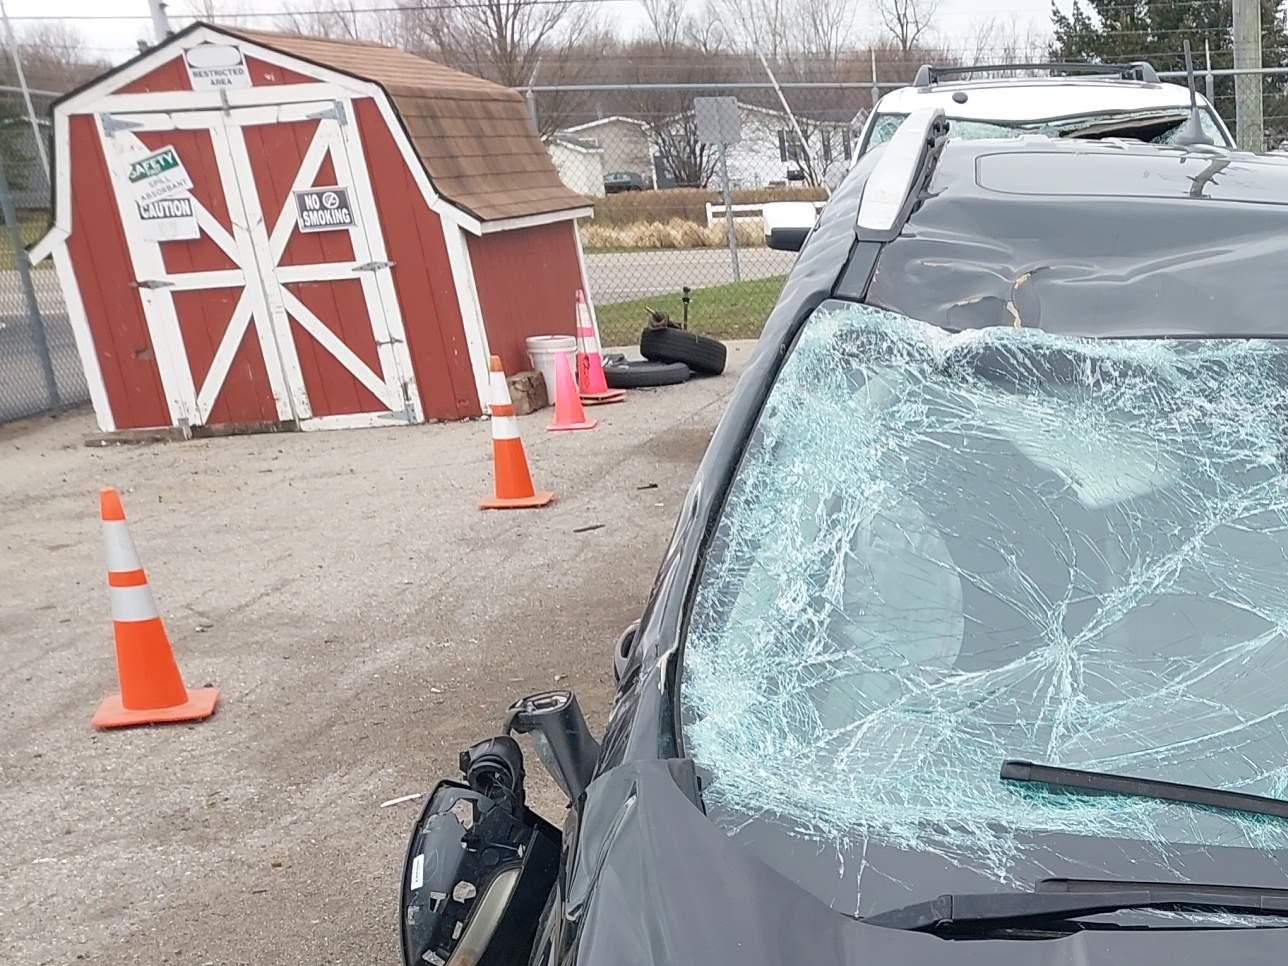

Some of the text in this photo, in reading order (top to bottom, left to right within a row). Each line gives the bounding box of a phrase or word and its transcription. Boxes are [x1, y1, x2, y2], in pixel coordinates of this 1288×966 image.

[192, 67, 244, 78] RESTRICTED
[210, 78, 233, 86] AREA
[129, 150, 175, 179] SAFETY
[141, 199, 192, 219] CAUTION
[303, 193, 320, 210] NO
[302, 207, 351, 226] SMOKING
